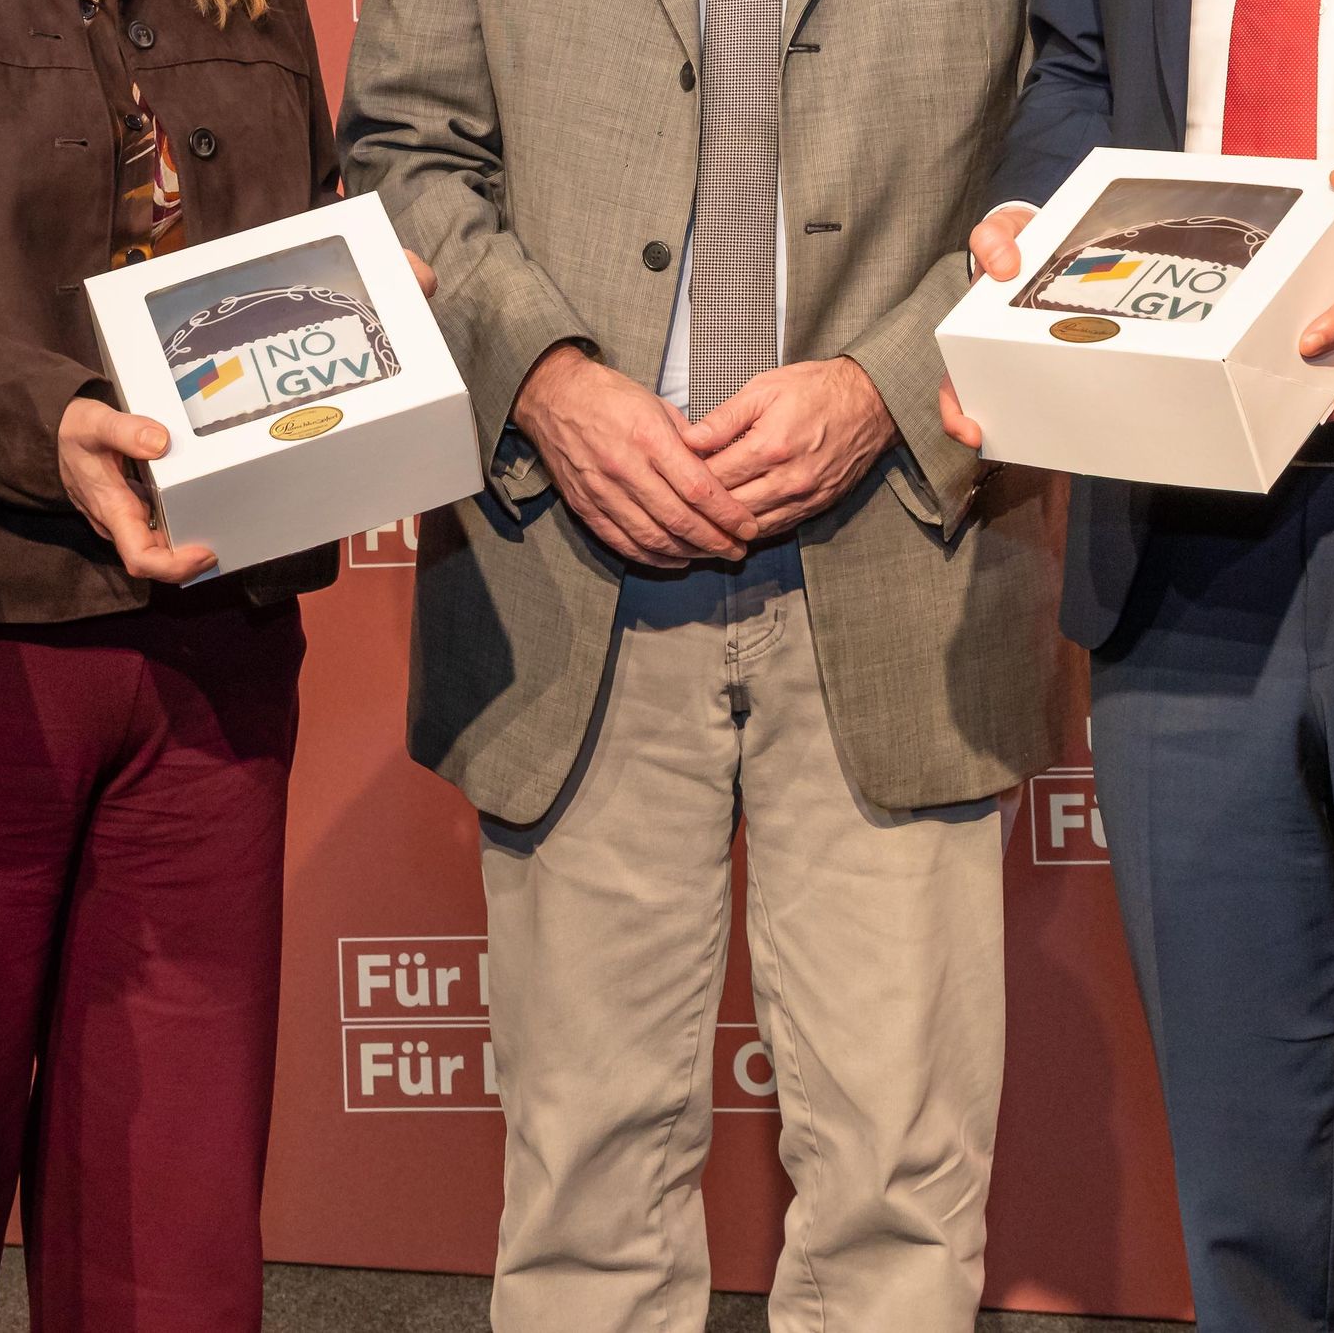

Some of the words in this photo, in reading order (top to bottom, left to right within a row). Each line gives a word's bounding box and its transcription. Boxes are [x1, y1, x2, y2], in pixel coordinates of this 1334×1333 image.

[1153, 265, 1227, 293] NÖ
[266, 325, 336, 368] NÖ
[276, 352, 370, 396] GVV
[357, 952, 461, 1007] Für
[360, 1041, 464, 1096] Für
